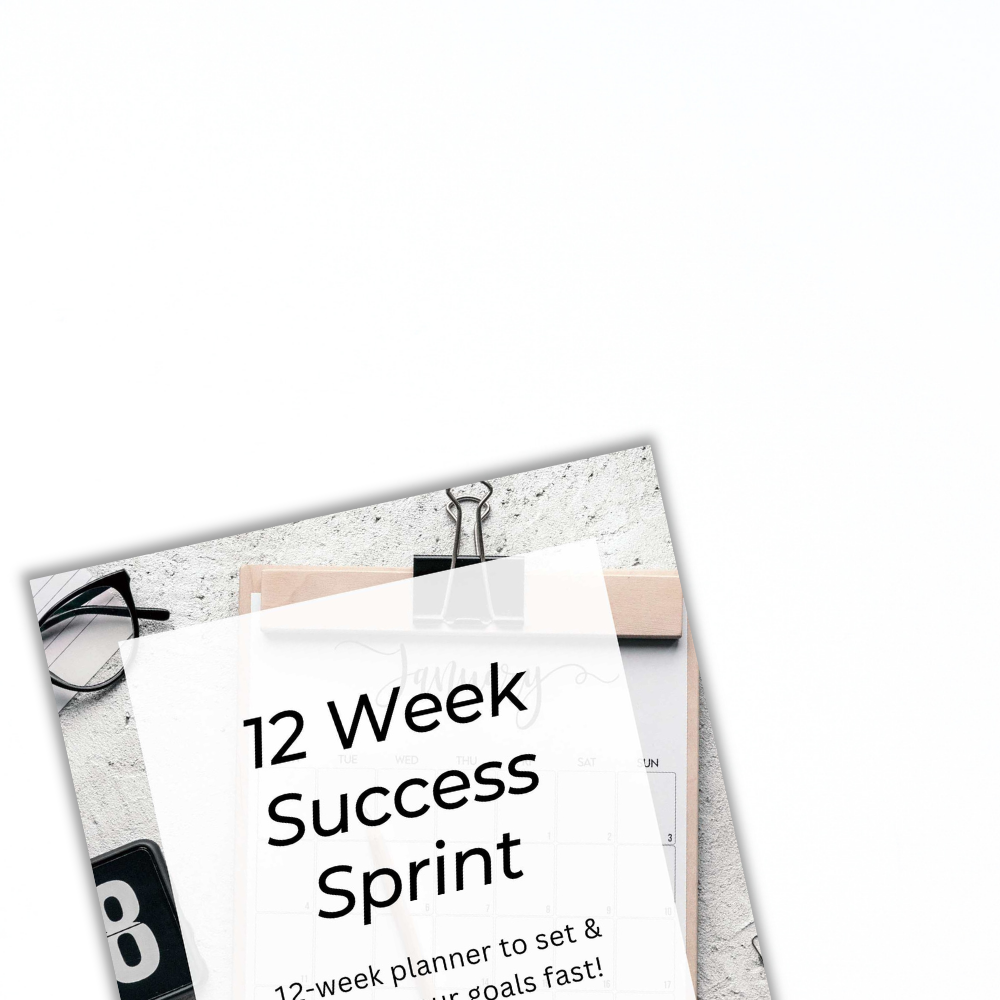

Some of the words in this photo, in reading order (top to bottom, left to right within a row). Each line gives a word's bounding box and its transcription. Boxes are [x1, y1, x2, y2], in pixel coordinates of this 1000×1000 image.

[244, 710, 307, 769] 12
[326, 661, 528, 750] Week
[267, 753, 540, 847] Success
[337, 754, 358, 765] TUE
[394, 754, 419, 765] WED
[456, 755, 478, 766] THU
[577, 757, 597, 767] SAT
[637, 758, 659, 768] SUN
[318, 832, 524, 926] Sprint
[667, 833, 673, 843] 3
[96, 879, 161, 984] 8
[390, 945, 491, 988] planner
[498, 938, 527, 958] to
[535, 924, 577, 950] set
[584, 918, 603, 939] &
[543, 956, 604, 989] fast!
